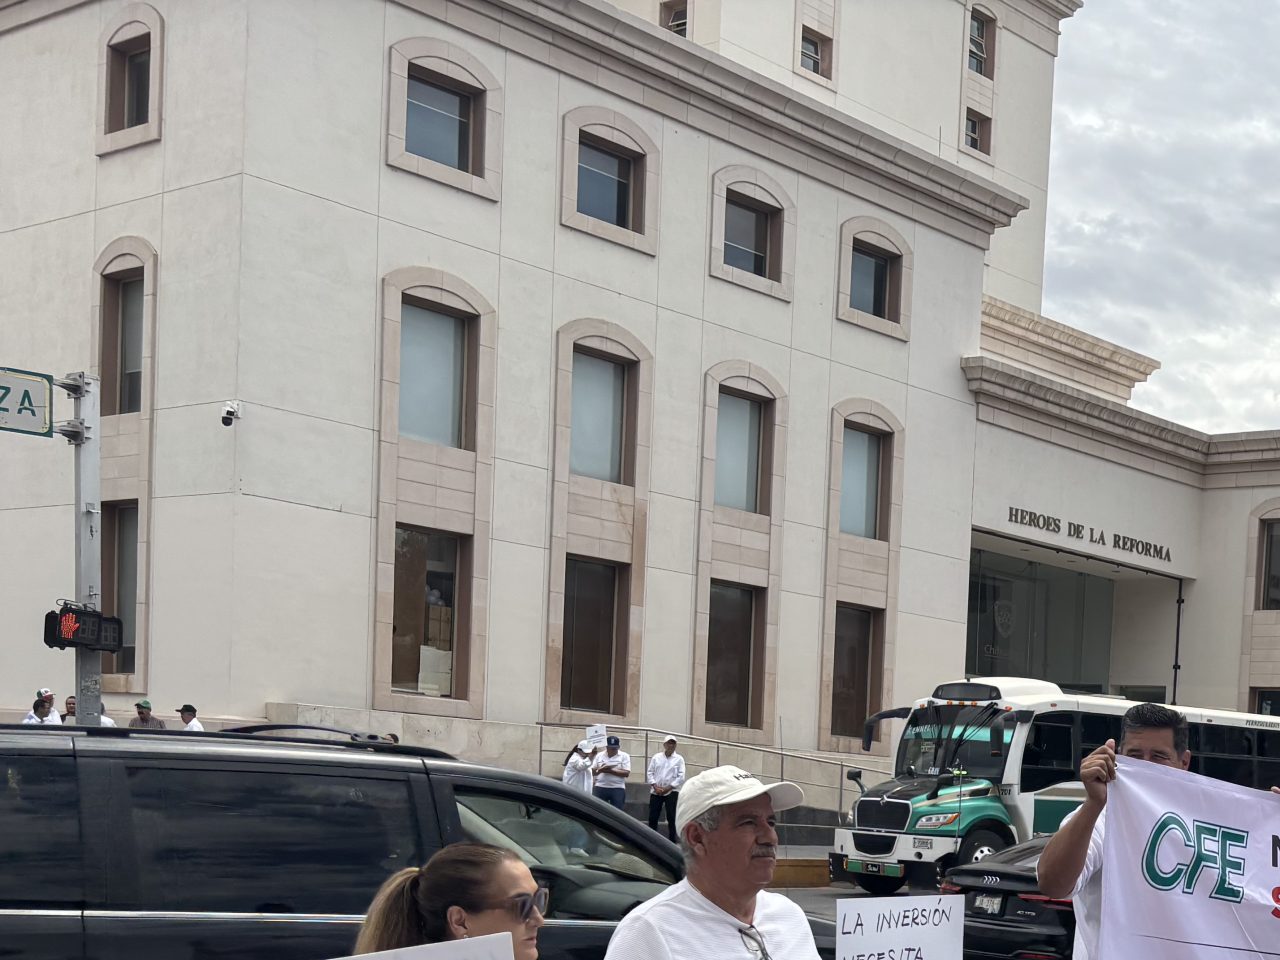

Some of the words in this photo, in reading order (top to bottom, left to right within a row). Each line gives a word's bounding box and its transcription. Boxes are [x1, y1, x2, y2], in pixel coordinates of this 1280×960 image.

[1008, 506, 1062, 533] HEROES
[1067, 521, 1085, 540] DE
[1089, 527, 1107, 546] LA
[1112, 533, 1172, 563] REFORMA
[1141, 811, 1249, 904] CFE
[841, 913, 864, 936] LA
[876, 898, 952, 933] INVERSIÓN
